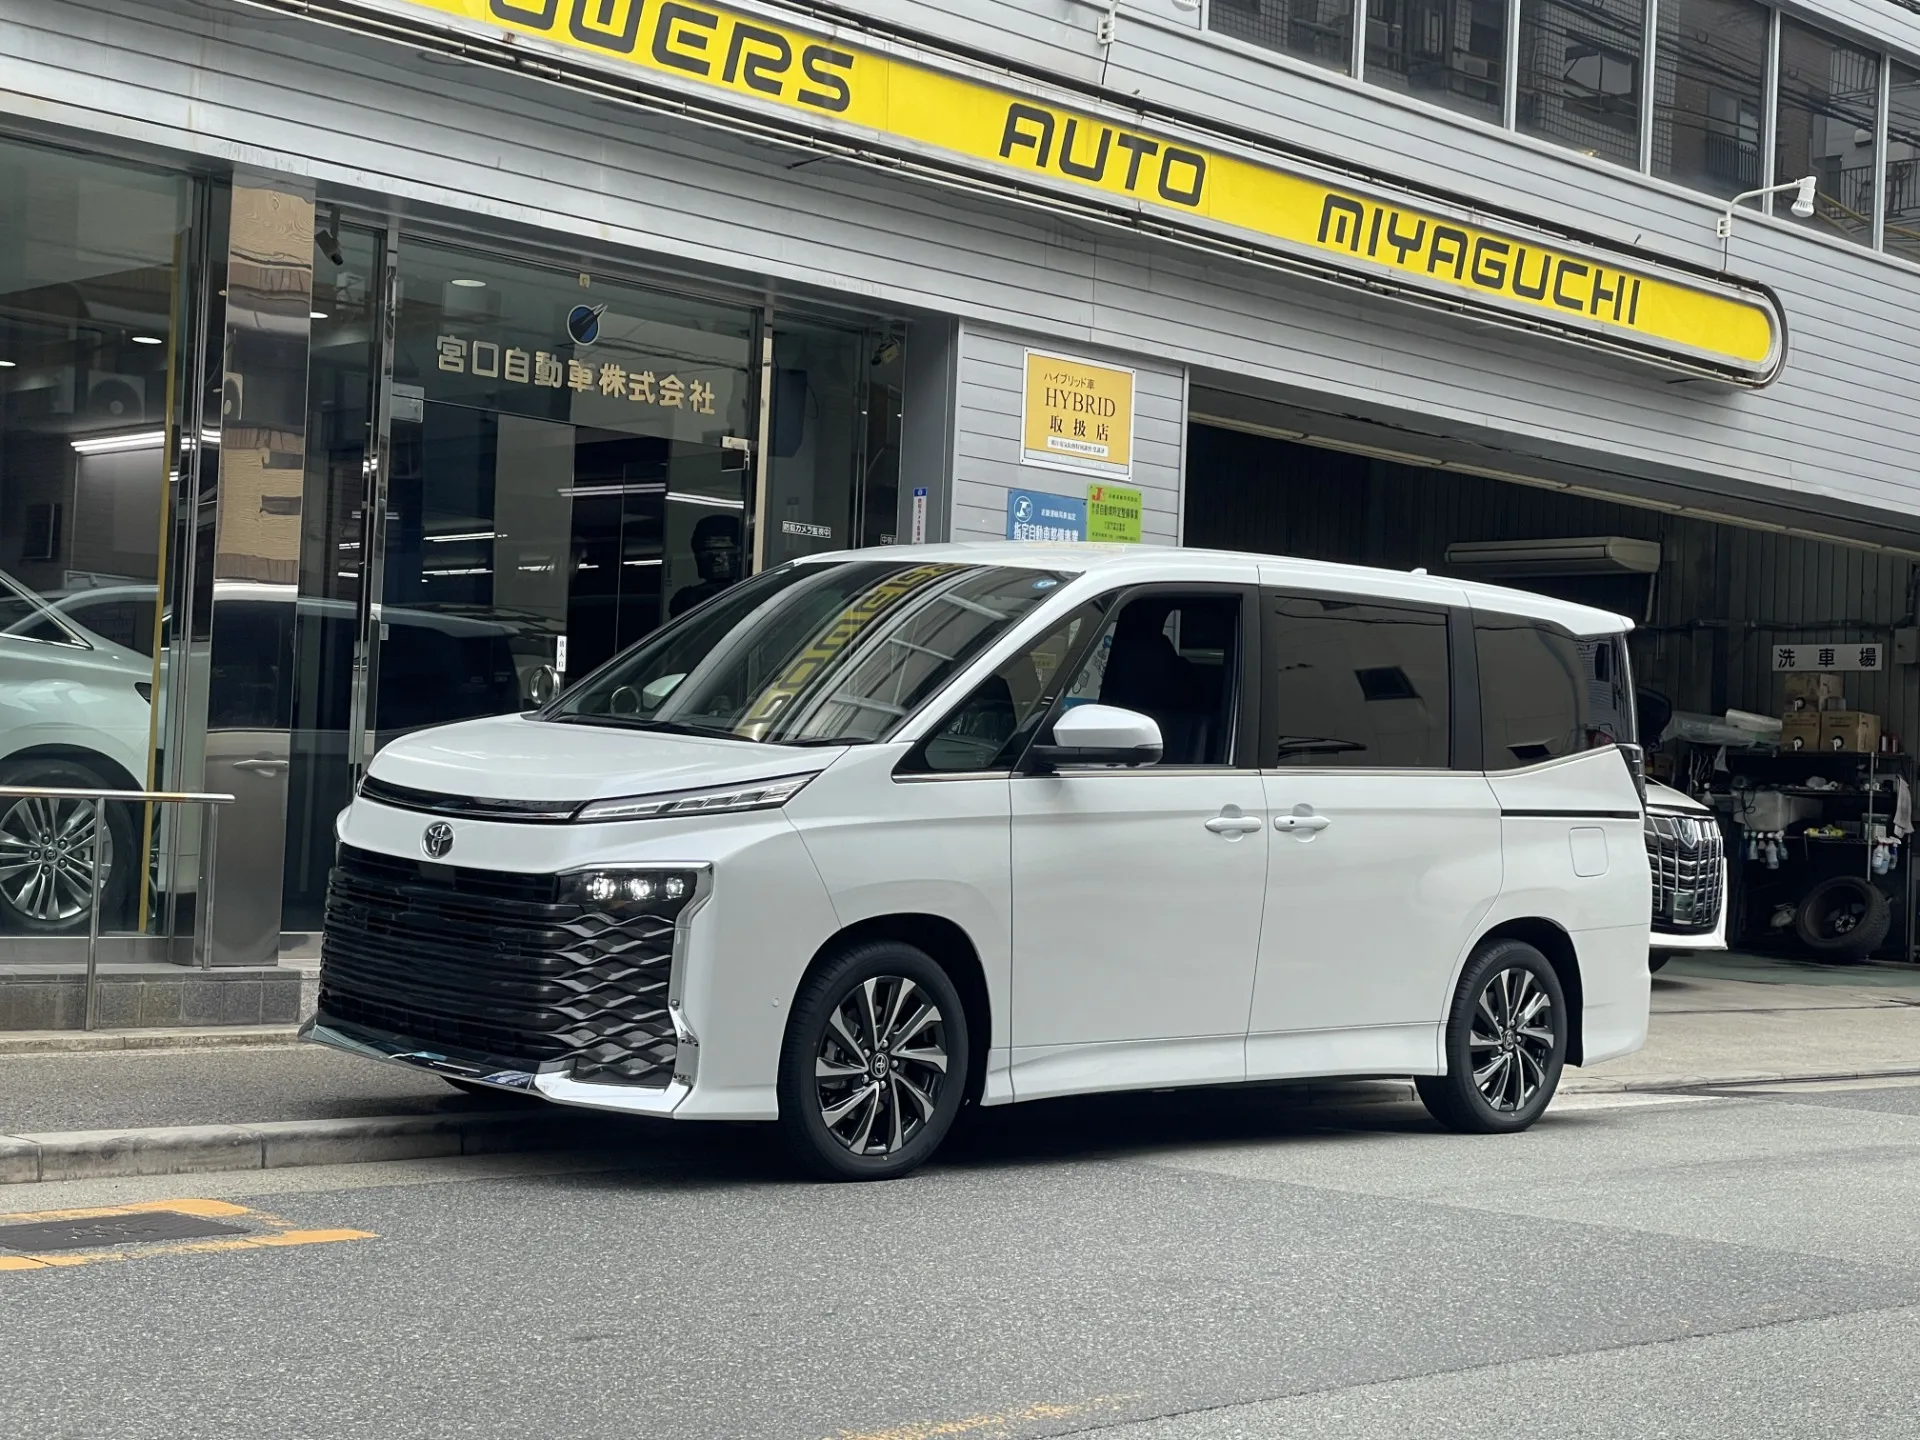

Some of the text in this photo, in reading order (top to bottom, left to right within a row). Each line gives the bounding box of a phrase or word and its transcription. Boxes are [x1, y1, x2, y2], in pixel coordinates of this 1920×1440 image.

[1000, 102, 1207, 206] AUTO
[1317, 194, 1642, 325] MIYAGUCHI
[436, 334, 716, 416] 宮口自動車株式会社
[1043, 372, 1095, 391] ハイブリッド車
[1045, 387, 1116, 418] HYBRID
[1050, 415, 1110, 442] 取扱店
[1778, 647, 1877, 668] 洗車場
